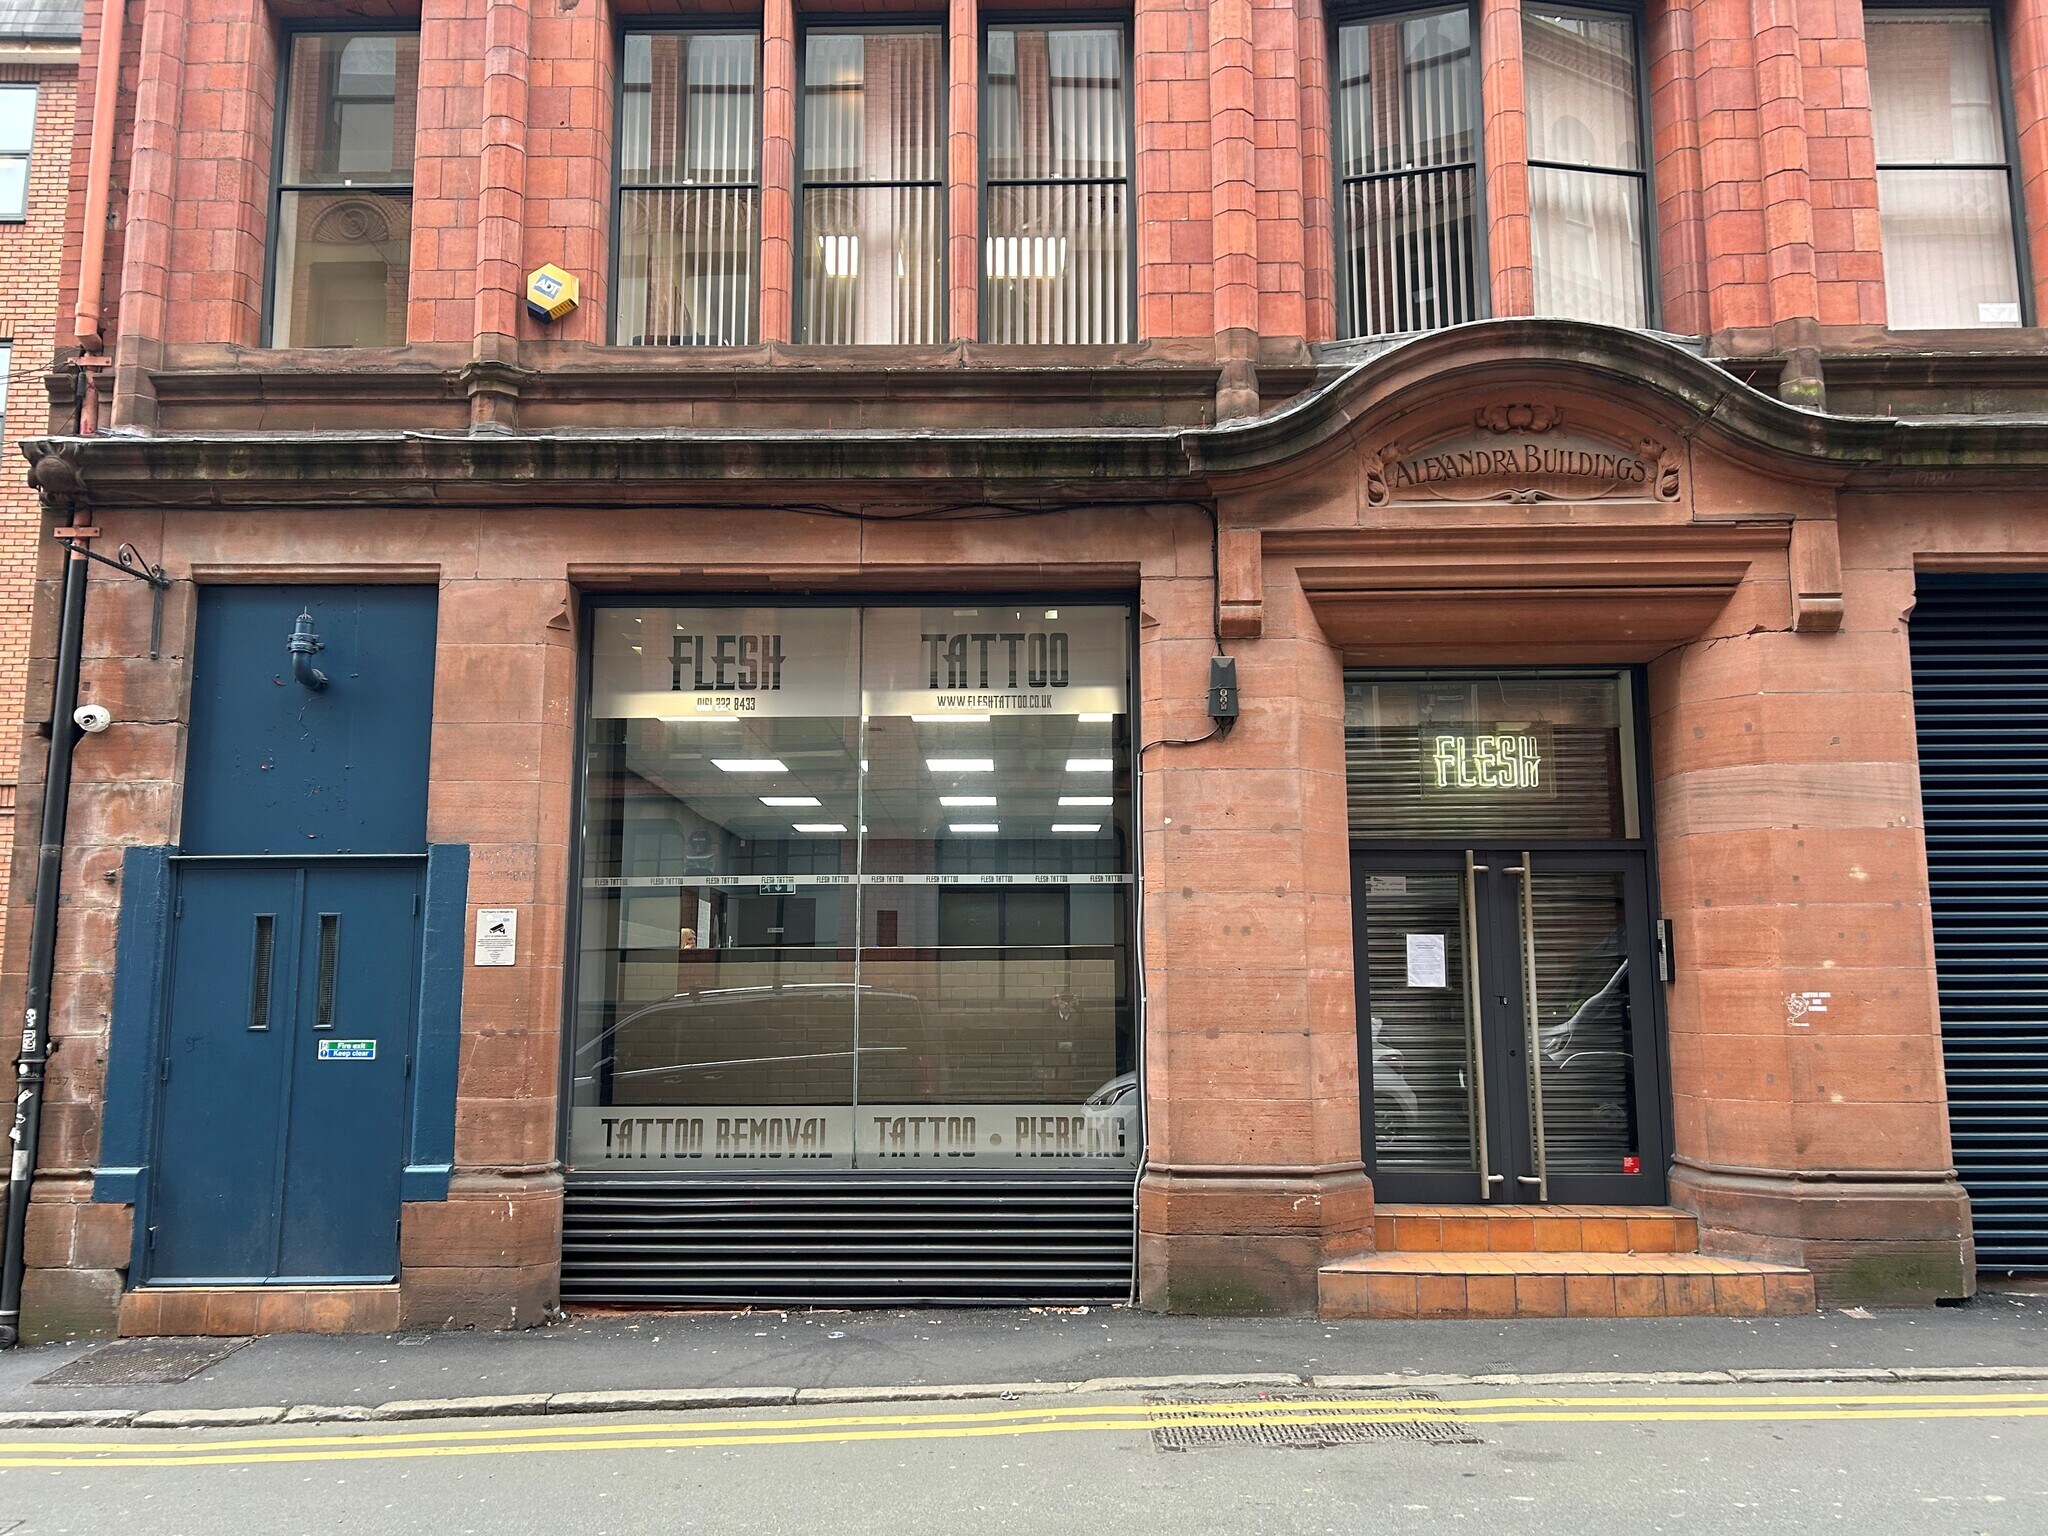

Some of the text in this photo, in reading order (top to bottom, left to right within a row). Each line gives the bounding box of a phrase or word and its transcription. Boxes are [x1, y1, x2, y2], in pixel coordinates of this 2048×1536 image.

[535, 278, 562, 295] ADT
[1395, 444, 1647, 488] ALEXANDRA BUILDINGS
[668, 635, 786, 691] FLESH
[921, 633, 1069, 689] TATTOO
[734, 697, 756, 711] 8433
[937, 695, 1052, 708] WWWFLESHTATTOO.CO.UK
[1433, 736, 1541, 788] FLESH
[761, 876, 775, 884] FLESH
[601, 1118, 832, 1158] TATTOO REMOVAL
[873, 1116, 1125, 1157] TATTOO PIERCING
